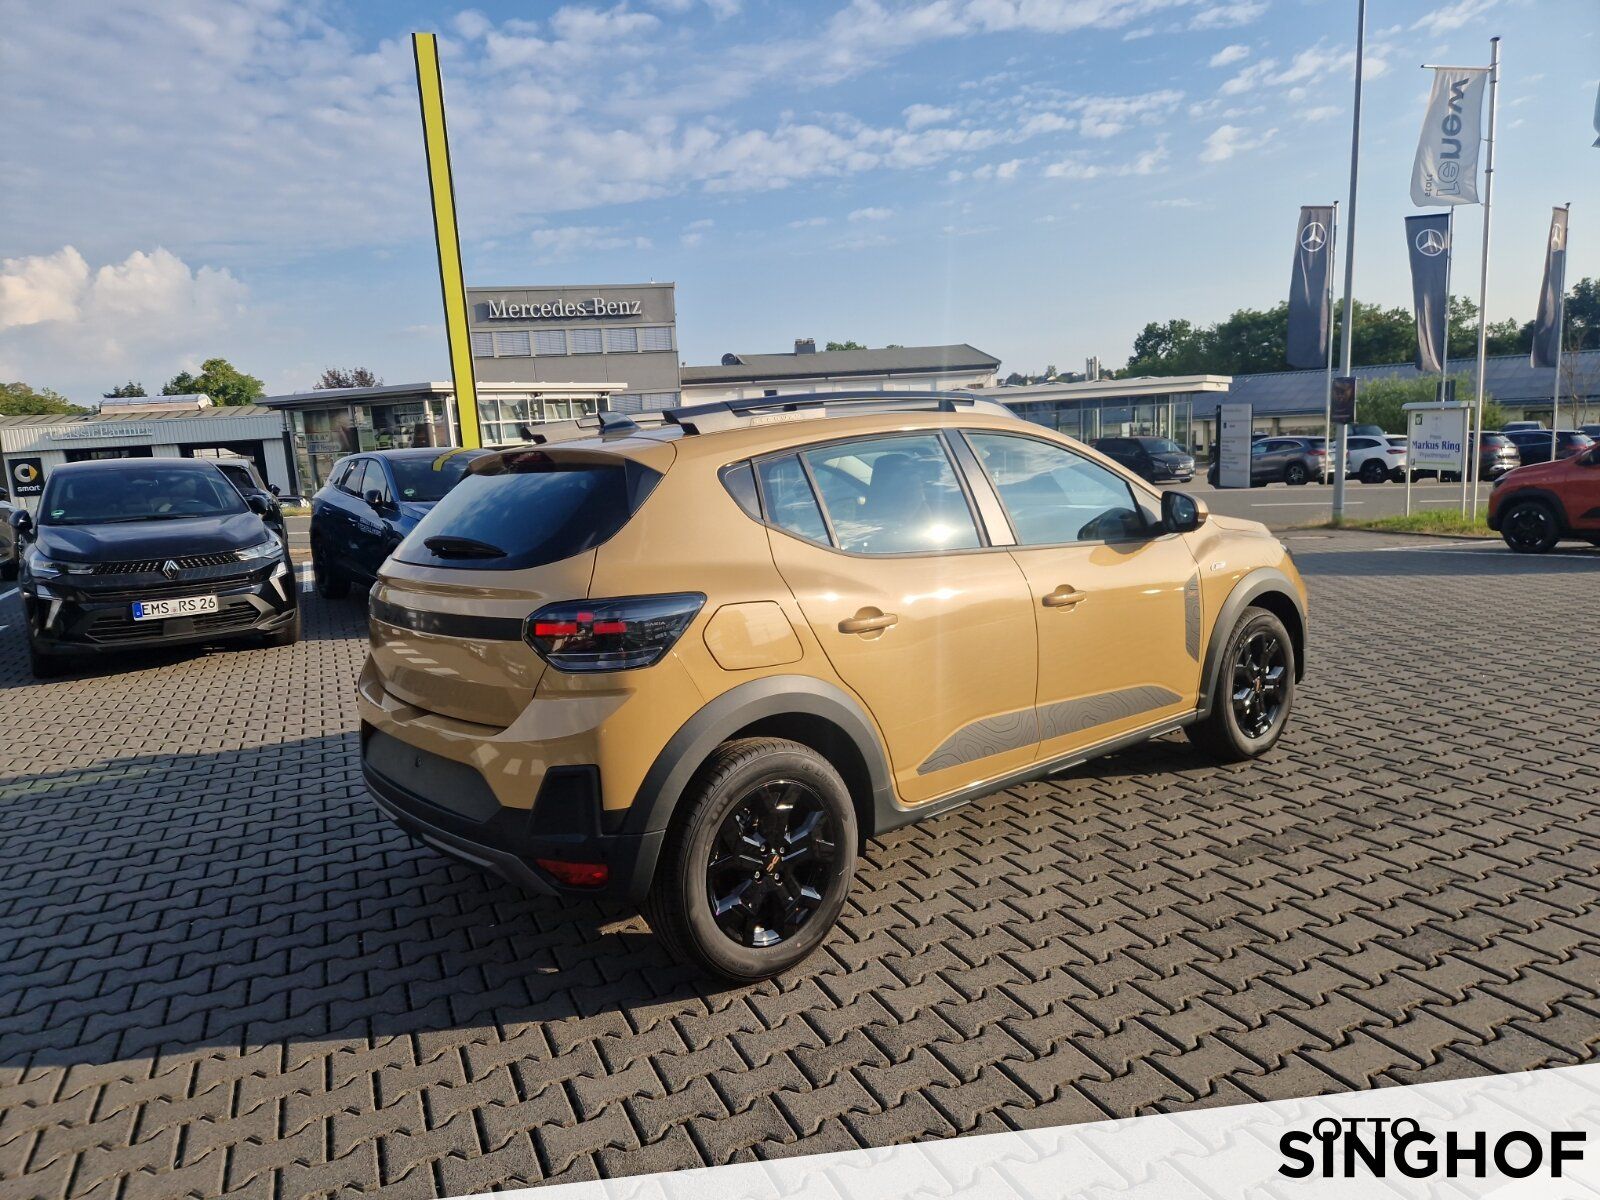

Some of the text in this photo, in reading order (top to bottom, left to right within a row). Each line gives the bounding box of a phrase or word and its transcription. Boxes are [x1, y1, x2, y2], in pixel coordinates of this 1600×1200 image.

[488, 297, 642, 319] Mercedes-Benz
[1411, 440, 1461, 453] Markus Ring
[142, 597, 216, 616] EMS RS 26
